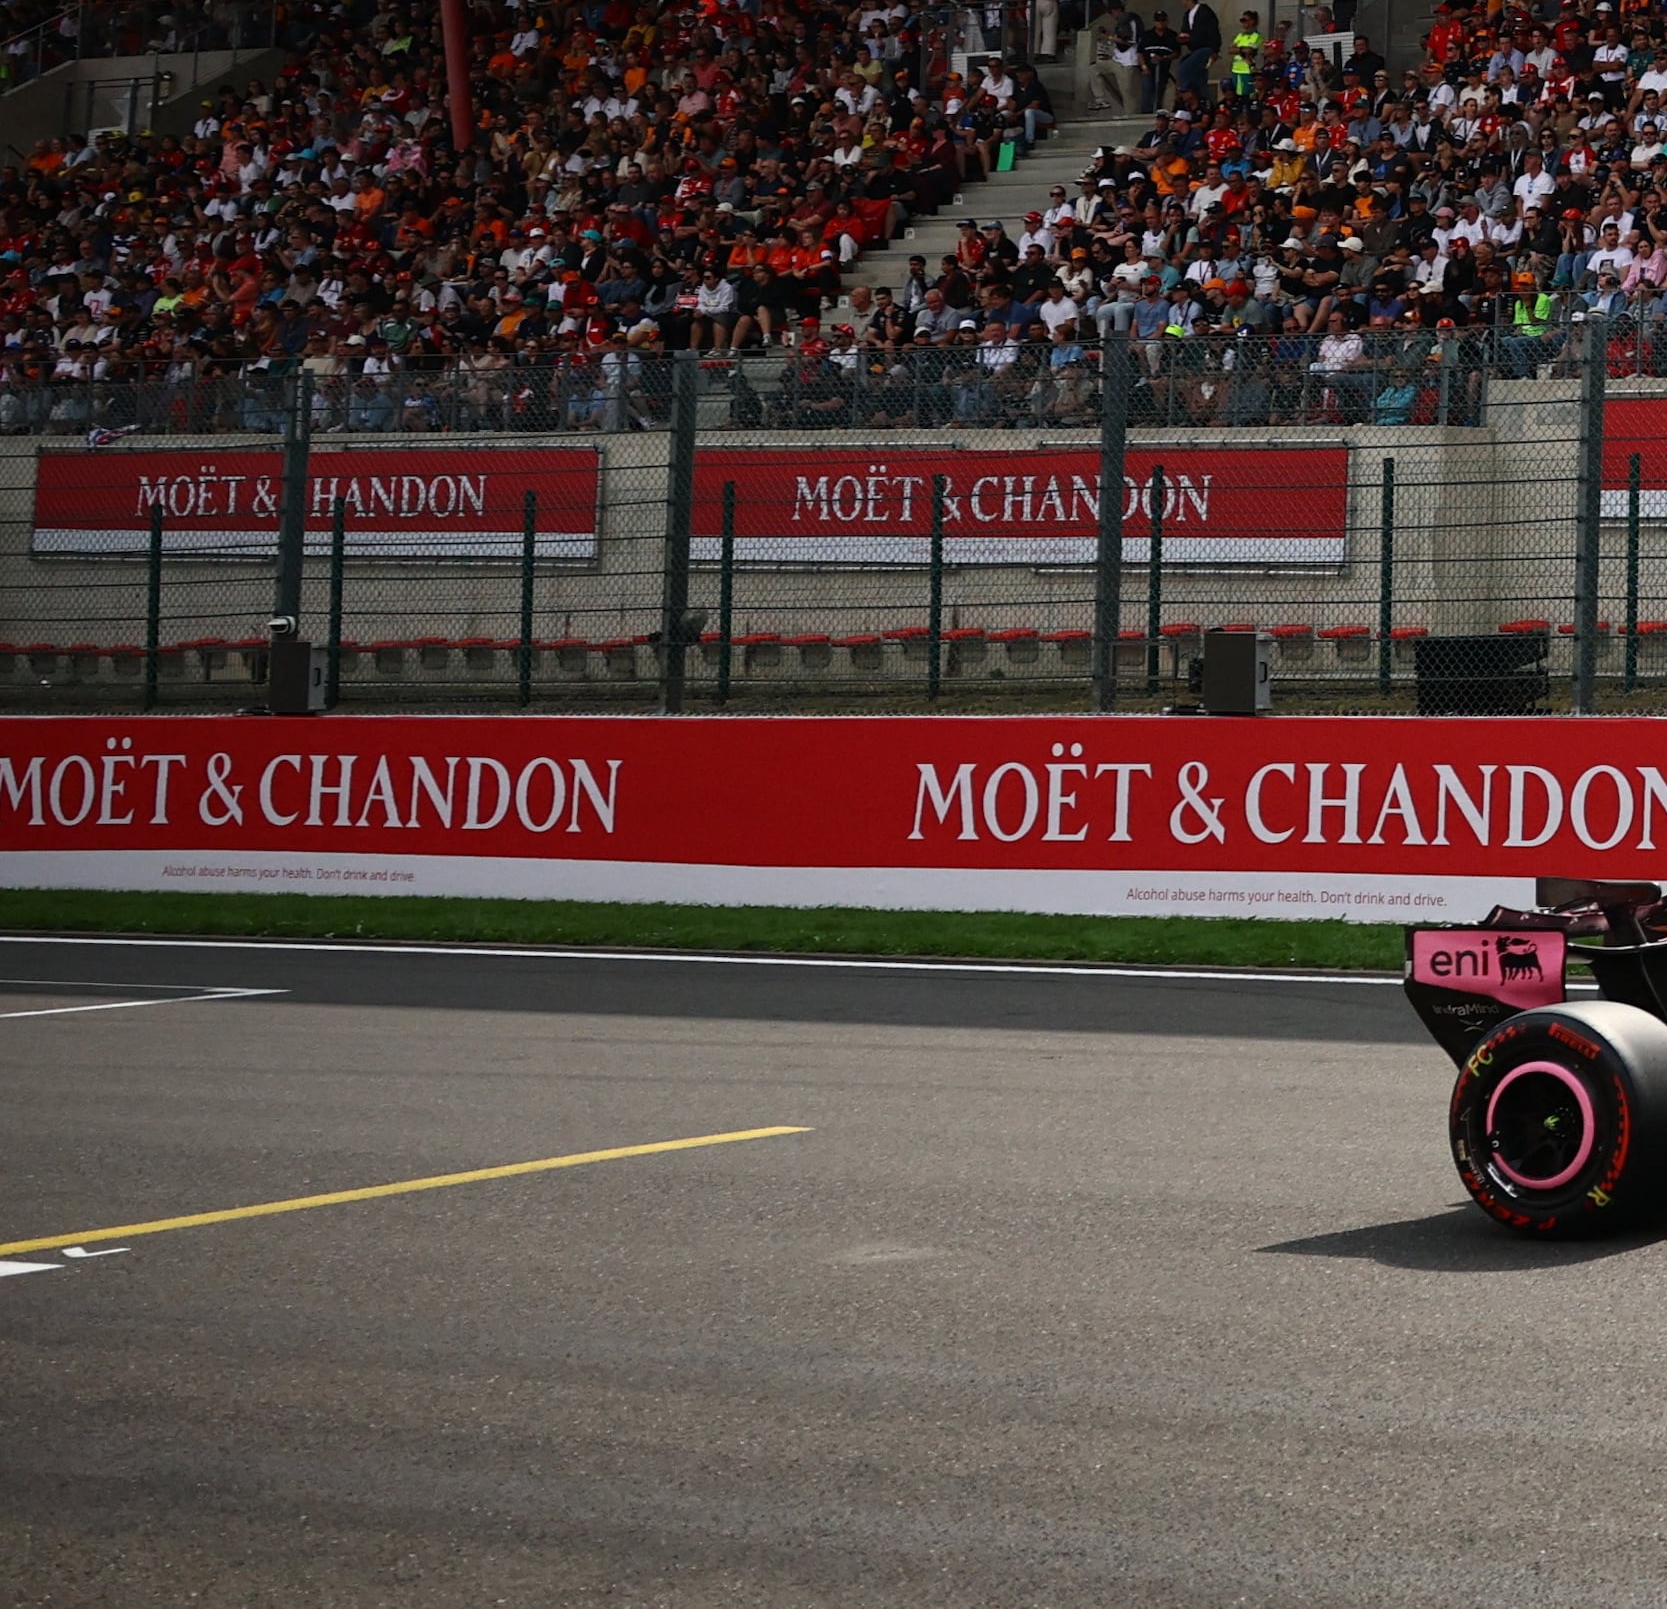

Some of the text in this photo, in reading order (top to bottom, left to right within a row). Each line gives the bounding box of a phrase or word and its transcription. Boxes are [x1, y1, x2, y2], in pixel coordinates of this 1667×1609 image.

[135, 465, 488, 518] MOËT & HANDON
[791, 465, 924, 521] MOËT
[0, 738, 623, 834] MOËT & CHANDON
[908, 743, 1152, 842] MOËT
[1170, 761, 1225, 845] &
[162, 866, 196, 878] Alcohol
[198, 867, 225, 878] abuse
[227, 867, 257, 878] harms
[258, 870, 281, 880] your
[283, 867, 312, 879] health.
[343, 870, 367, 880] drink
[370, 870, 388, 881] and
[1126, 888, 1447, 906] Alcohol abuse harms your health. Don't drink and drive.
[1430, 941, 1490, 977] eni
